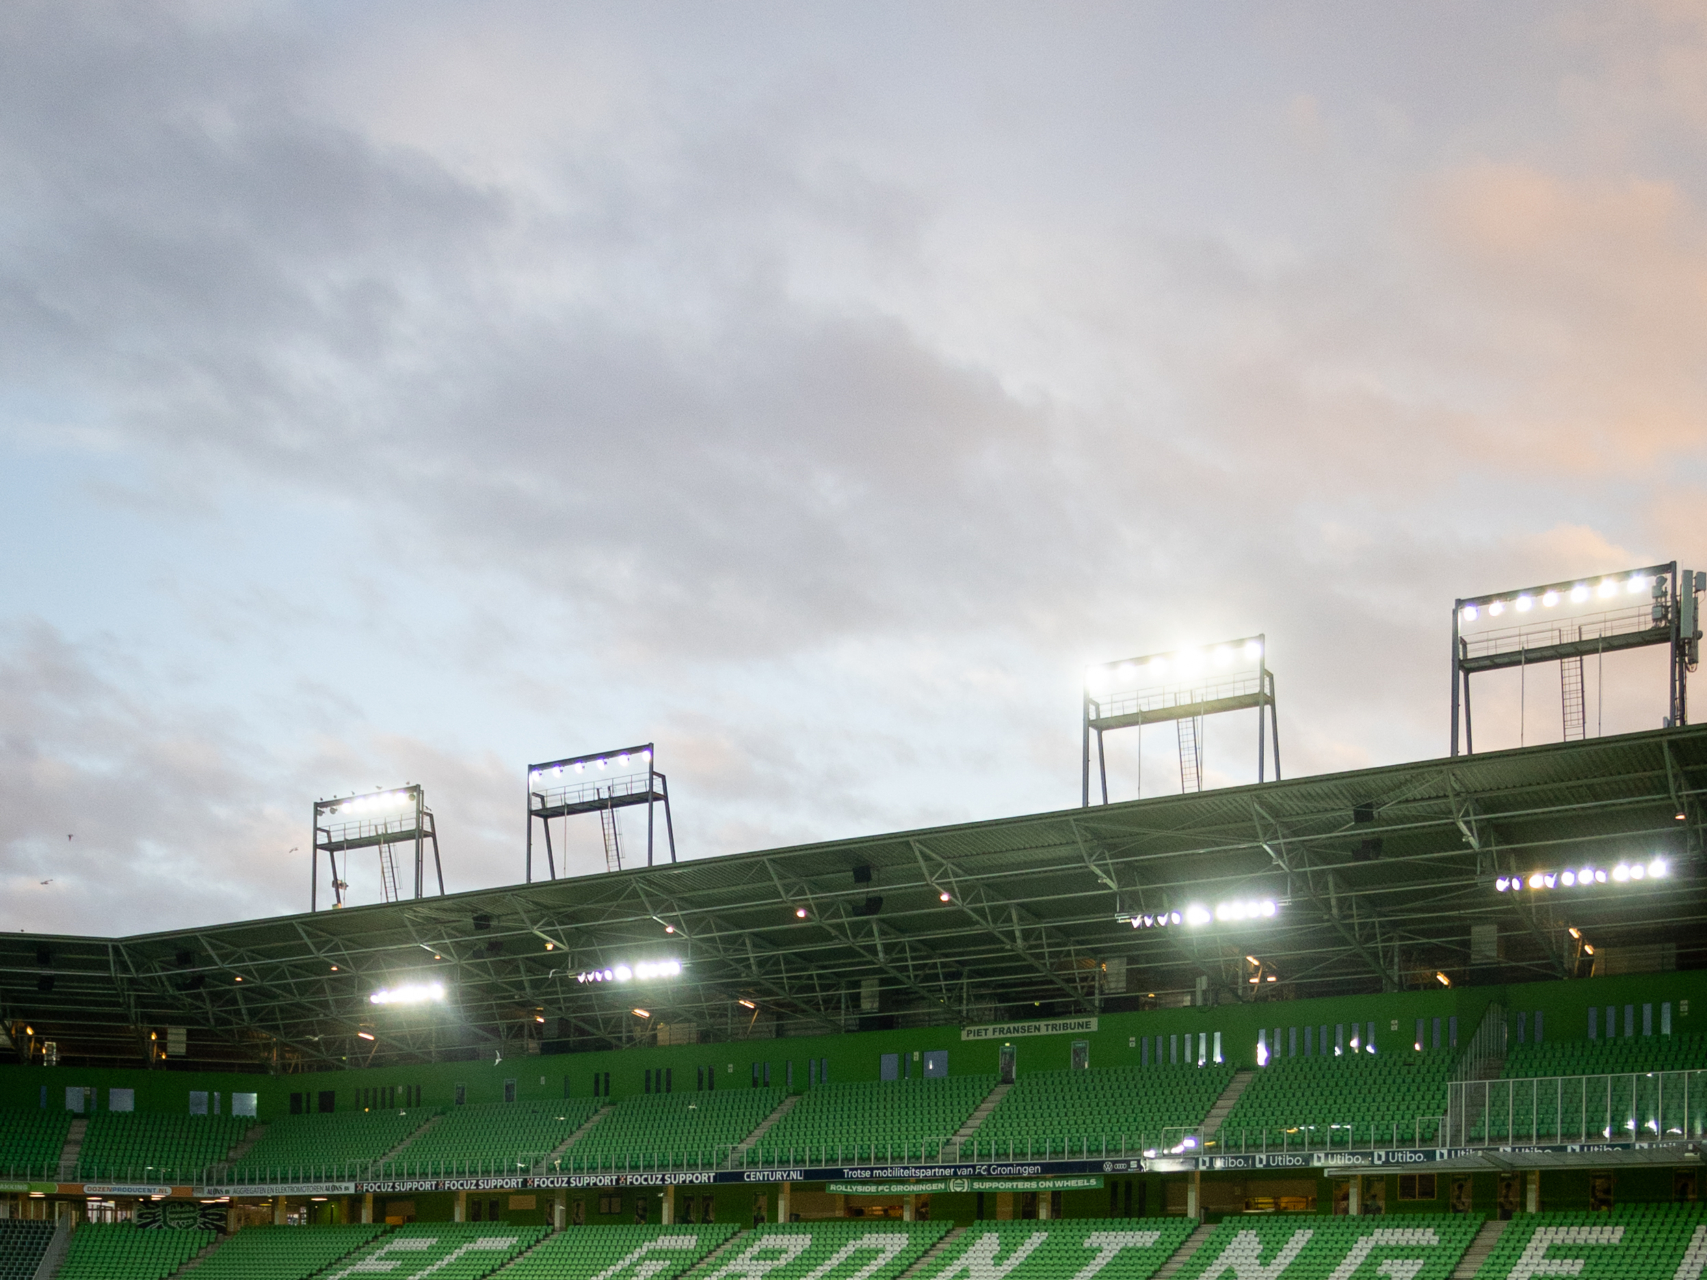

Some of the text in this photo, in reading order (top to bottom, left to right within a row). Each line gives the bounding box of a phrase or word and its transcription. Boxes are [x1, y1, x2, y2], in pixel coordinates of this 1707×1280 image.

[966, 1021, 1092, 1037] PIET FRANSEN TRIBUNE
[1270, 1155, 1305, 1166] Utibo.
[1328, 1153, 1365, 1164] Utibo.
[1388, 1151, 1427, 1163] Utibo.
[744, 1170, 803, 1181] CENTURY.NL
[843, 1169, 871, 1178] Trotse
[873, 1167, 954, 1178] mobiliteitspartner
[975, 1165, 988, 1175] FC
[990, 1164, 1041, 1176] Groningen
[445, 1178, 523, 1190] FOCUZ SUPPORT
[534, 1175, 618, 1188] FOCUZ SUPPORT
[627, 1172, 716, 1185] FOCUZ SUPPORT
[973, 1178, 1097, 1189] SUPPORTERS ON WHEELS
[87, 1186, 169, 1194] DOZENPRODUCENT.NL
[233, 1186, 266, 1195] AGGREGATEN
[267, 1186, 274, 1194] EN
[363, 1181, 437, 1192] FOCUZ SUPPORT
[830, 1182, 945, 1192] ROLLYSIDE FC GRONINGEN
